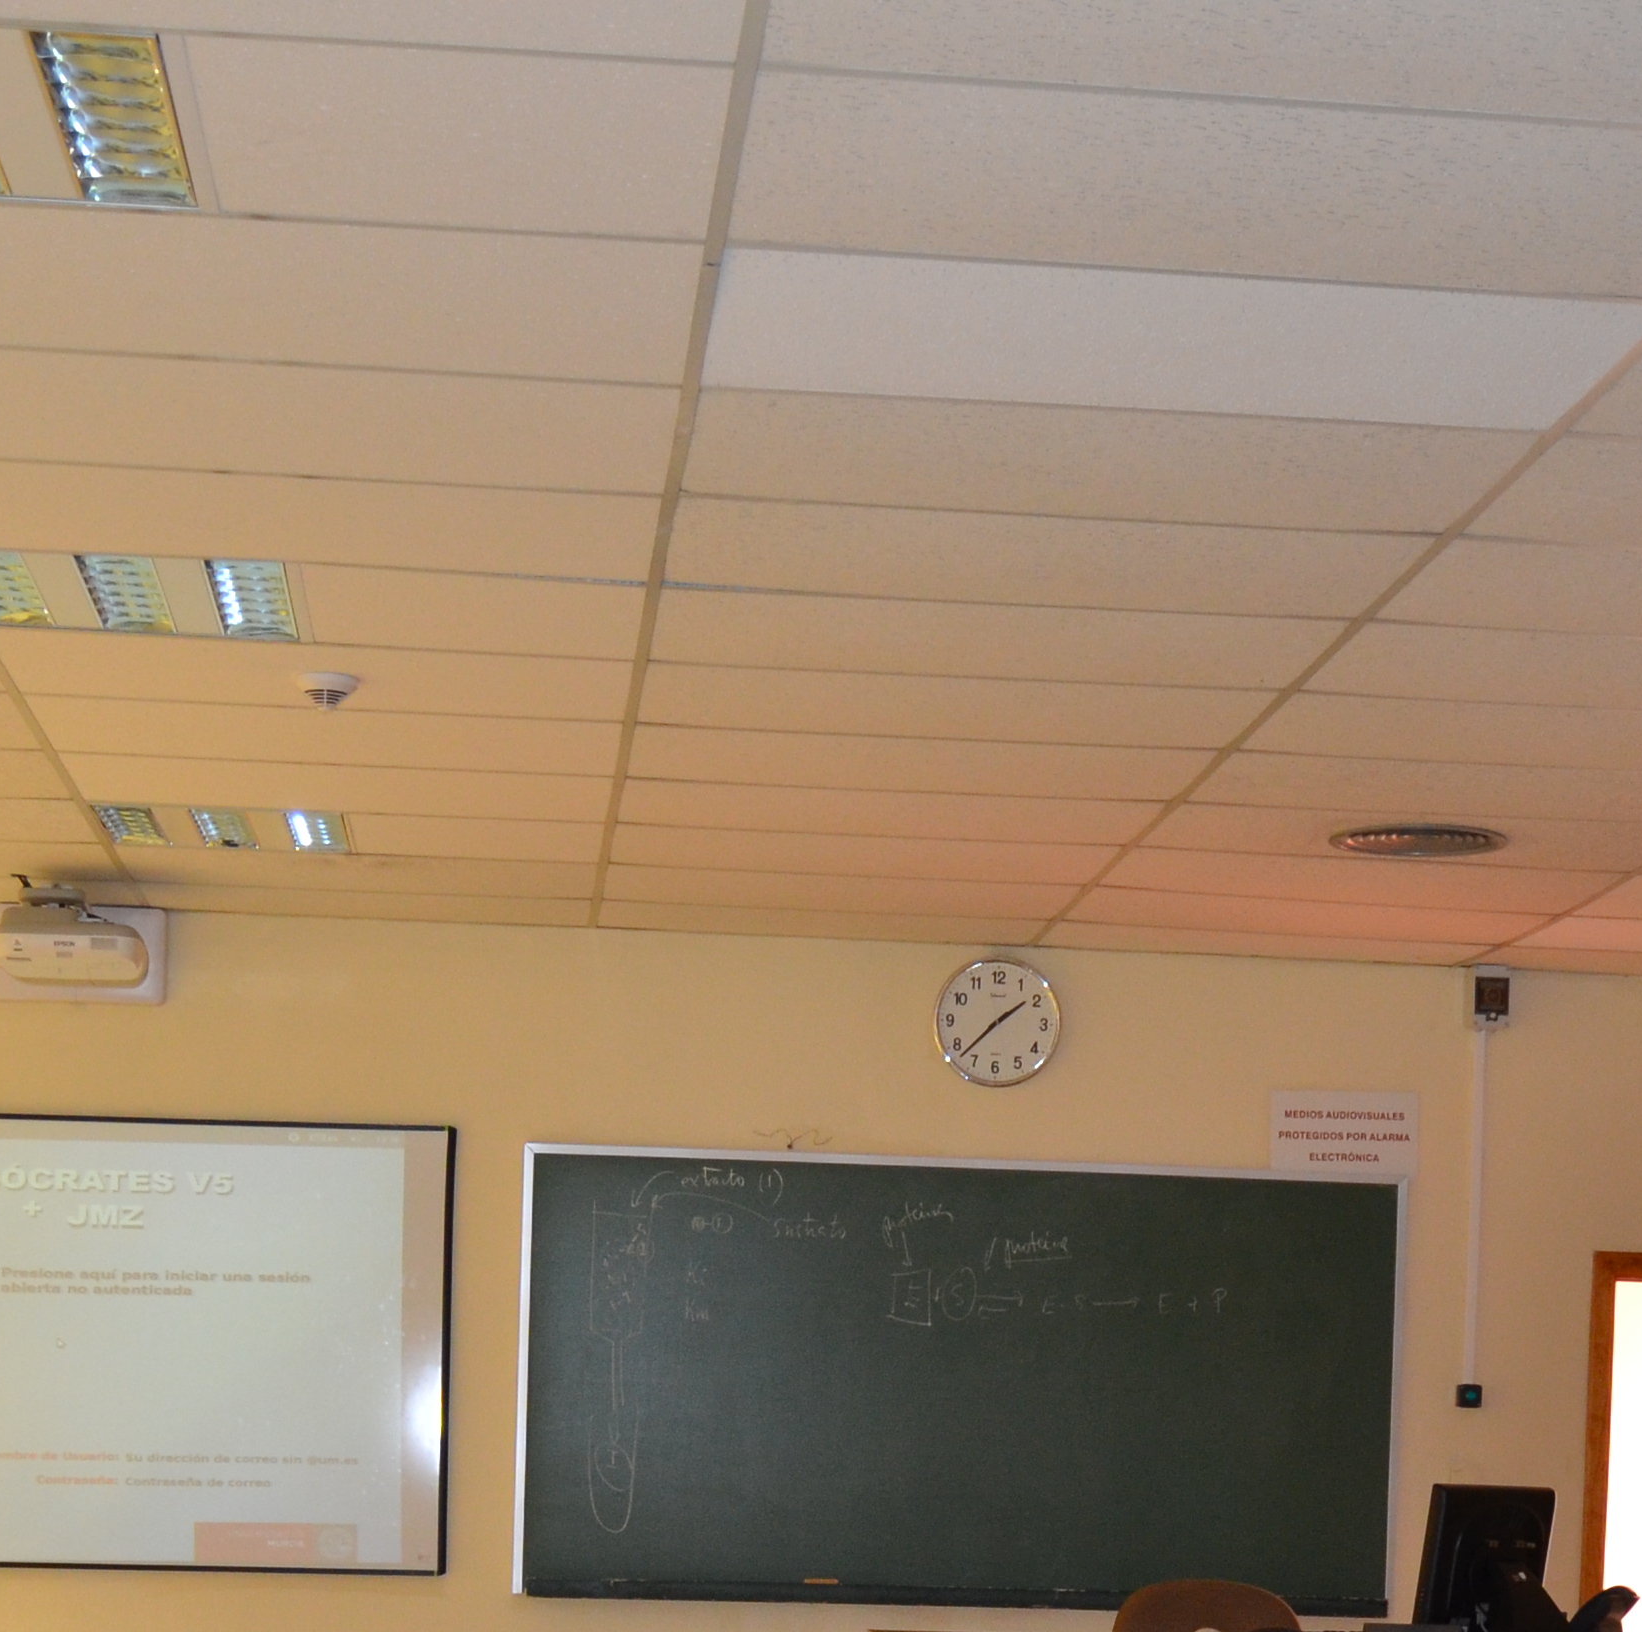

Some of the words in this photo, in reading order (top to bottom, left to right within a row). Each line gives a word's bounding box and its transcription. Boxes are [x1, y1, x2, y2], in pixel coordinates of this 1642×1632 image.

[971, 976, 982, 990] 11
[992, 971, 1006, 985] 12
[1018, 978, 1024, 992] 1
[954, 992, 968, 1006] 10
[1032, 994, 1042, 1008] 2
[945, 1013, 955, 1028] 9
[1039, 1018, 1049, 1032] 3
[952, 1037, 962, 1051] 8
[1030, 1041, 1039, 1055] 4
[970, 1054, 979, 1068] 7
[990, 1061, 1000, 1075] 6
[1013, 1056, 1023, 1070] 5
[1284, 1110, 1324, 1119] MEDIOS
[1327, 1111, 1406, 1122] AUDIOVISUALES
[1278, 1131, 1344, 1141] PROTEGIDOS
[1347, 1132, 1367, 1141] POR
[1369, 1133, 1411, 1142] ALARMA
[1309, 1151, 1380, 1163] ELECTRÓNICA
[188, 1173, 235, 1196] V5
[67, 1205, 145, 1230] JMZ
[1, 1267, 75, 1280] Presione
[80, 1268, 118, 1282] aquí
[123, 1271, 160, 1282] para
[165, 1270, 217, 1282] iniciar
[223, 1273, 252, 1282] una
[258, 1271, 311, 1283] sesión
[0, 1283, 61, 1294] abierta
[68, 1285, 87, 1295] no
[93, 1284, 193, 1297] autenticada
[147, 1453, 210, 1465] dirección
[214, 1455, 231, 1465] de
[234, 1456, 277, 1466] correo
[281, 1456, 303, 1466] sin
[207, 1479, 225, 1488] de
[228, 1480, 271, 1489] correo
